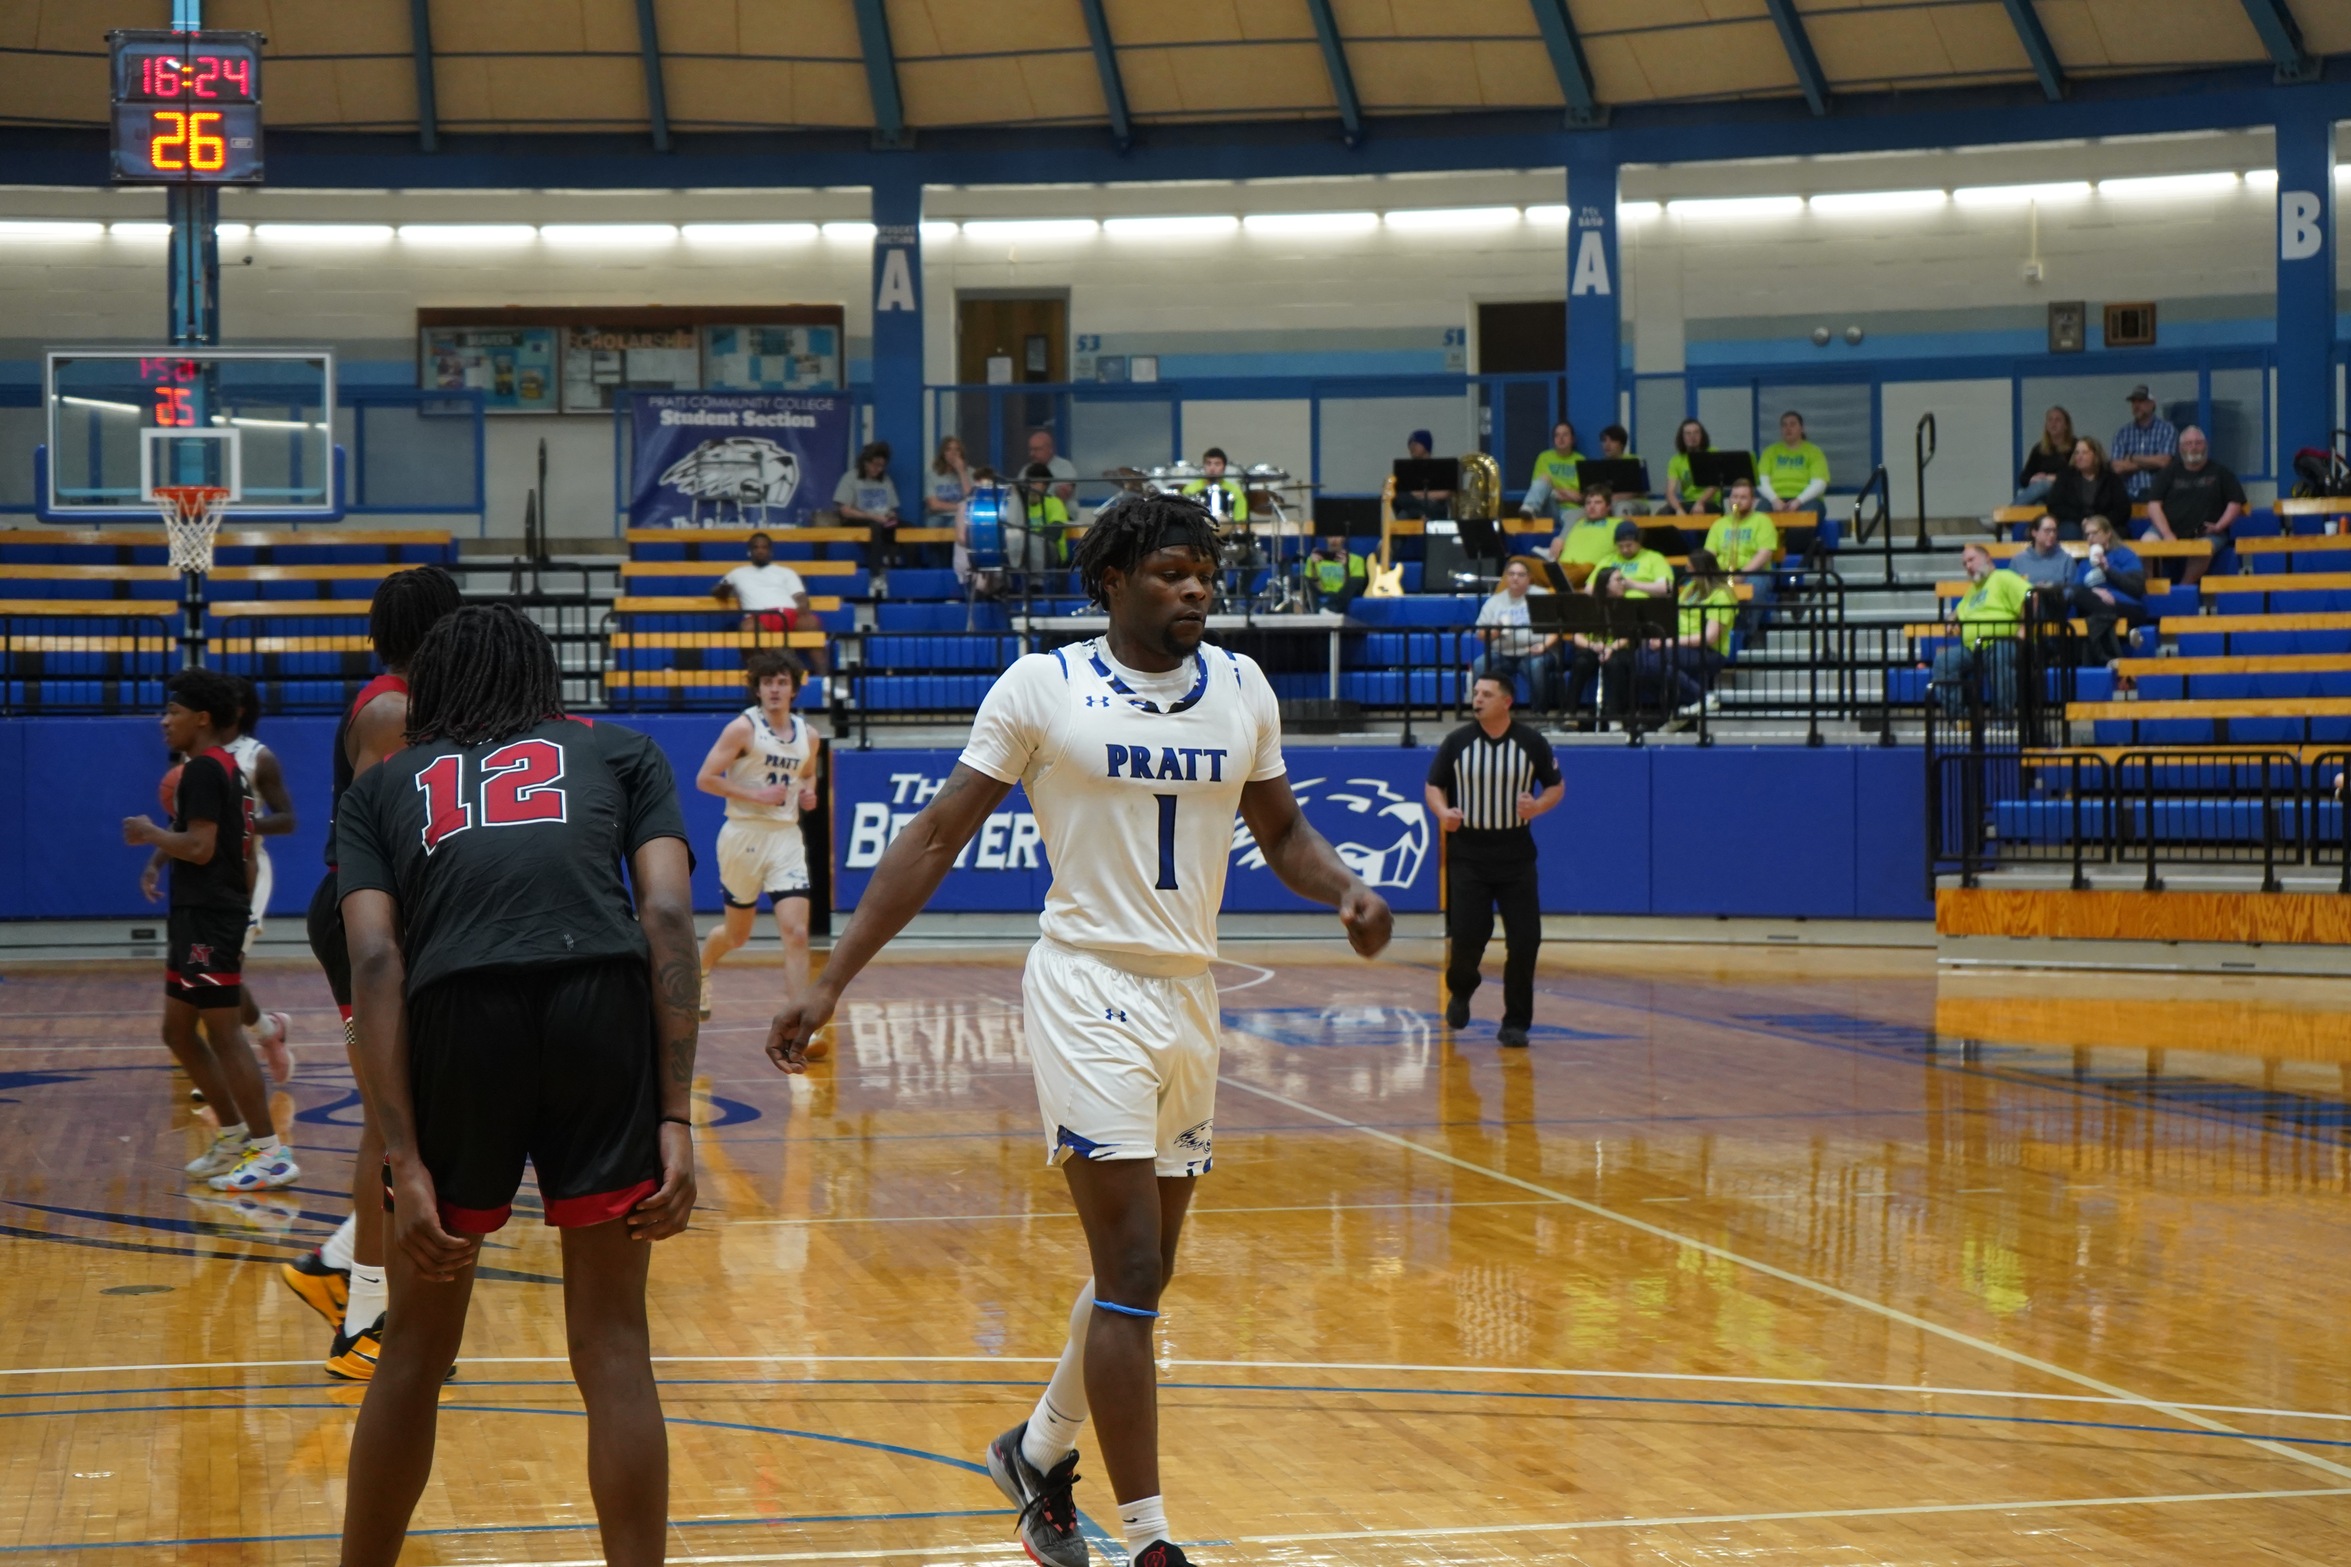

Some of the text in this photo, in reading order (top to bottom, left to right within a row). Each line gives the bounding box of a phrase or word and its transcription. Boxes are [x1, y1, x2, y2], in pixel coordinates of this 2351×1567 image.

[143, 56, 249, 97] 16:24
[152, 112, 225, 170] 26
[2281, 190, 2322, 260] B
[878, 249, 915, 311] A
[1571, 231, 1611, 295] A
[648, 395, 835, 411] PRATT COMMUNITY COLLEGE
[660, 409, 816, 428] Student Section
[765, 754, 800, 770] PRATT
[890, 773, 950, 804] TH
[1105, 744, 1227, 782] PRATT
[415, 738, 567, 856] 12
[845, 802, 1042, 870] BER
[1153, 793, 1178, 890] 1
